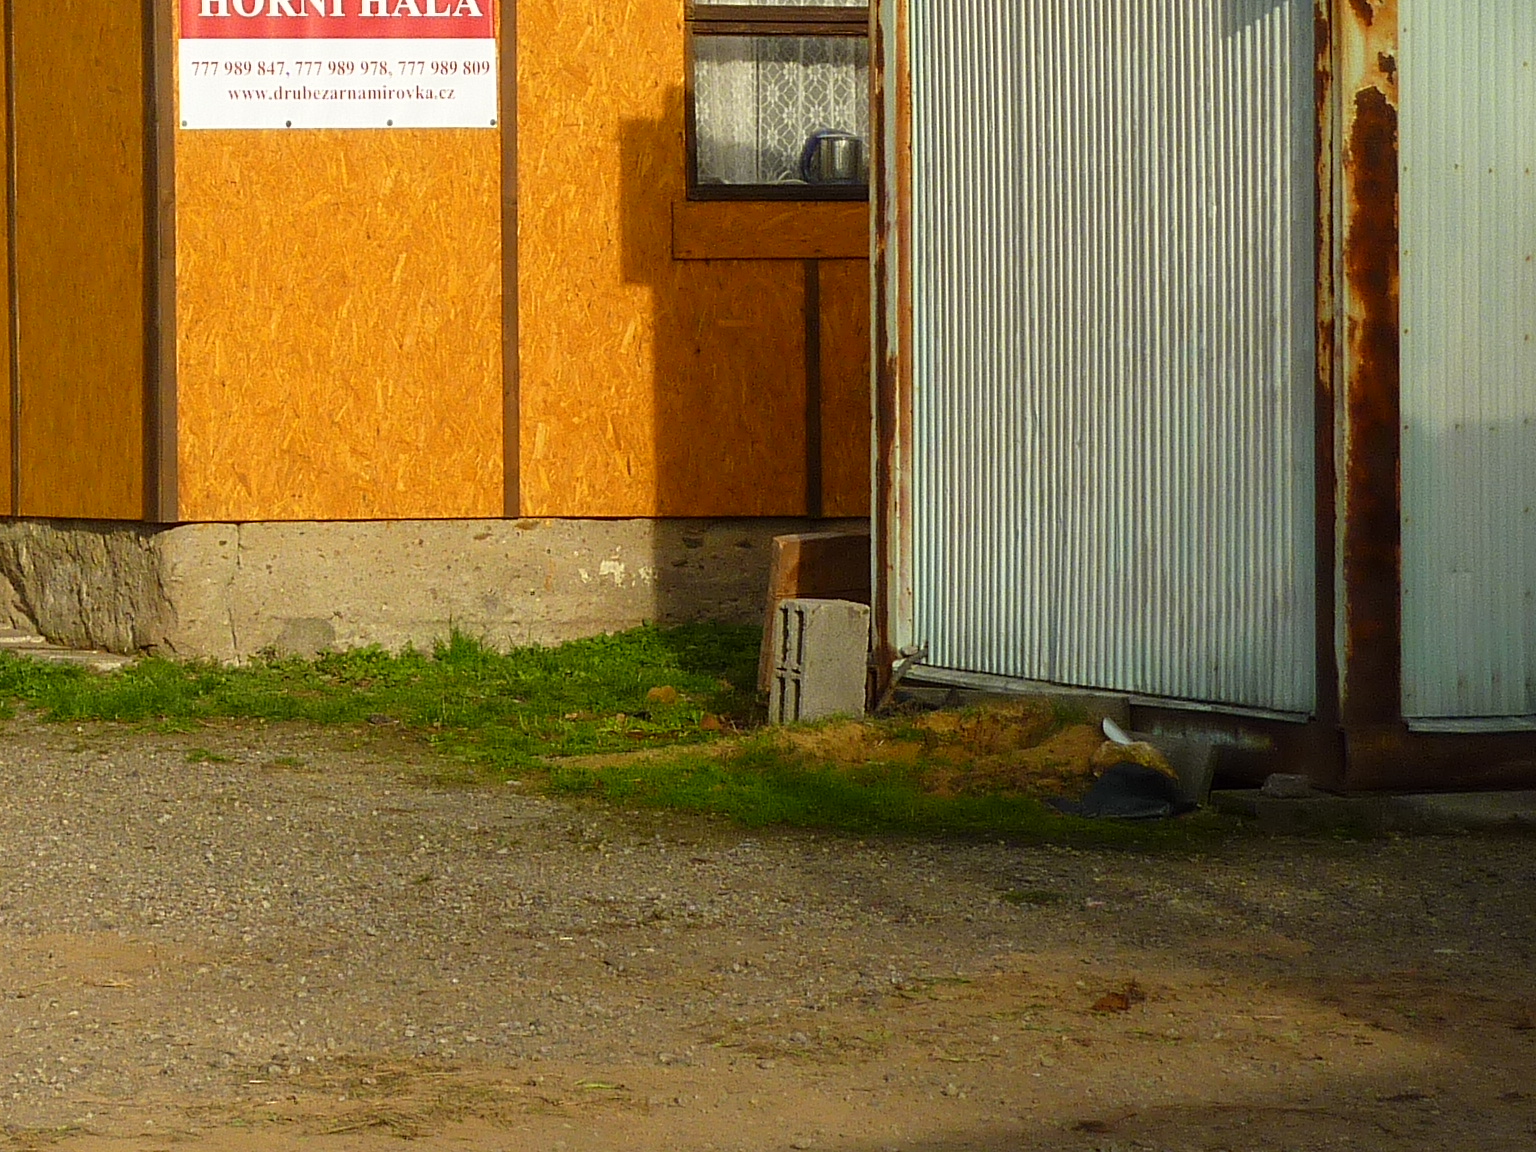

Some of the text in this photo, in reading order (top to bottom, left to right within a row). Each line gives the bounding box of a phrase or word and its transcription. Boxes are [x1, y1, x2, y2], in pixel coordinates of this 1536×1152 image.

[192, 61, 490, 78] 777 989 847, 777 989 978, 777 989 809
[228, 86, 456, 101] www.drubezarnamirovka.cz
